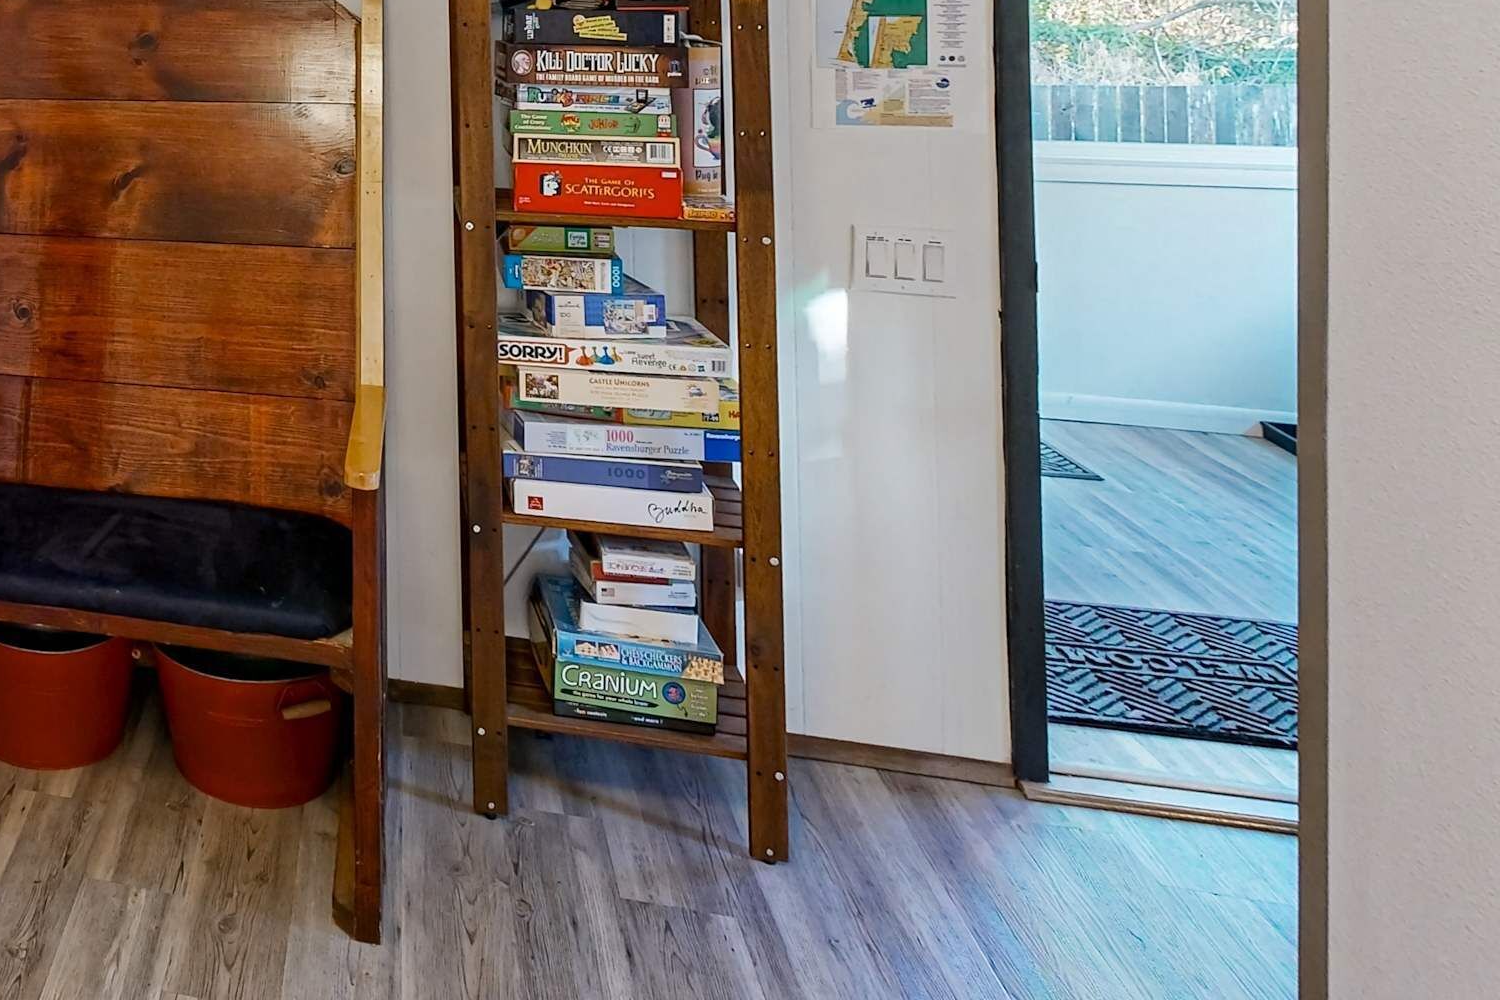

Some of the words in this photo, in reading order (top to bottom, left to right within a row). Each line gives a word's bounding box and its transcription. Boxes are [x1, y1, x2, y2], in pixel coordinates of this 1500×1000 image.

[536, 50, 564, 71] KILL
[566, 50, 614, 72] DOCTOR
[616, 51, 660, 73] LUCKY
[536, 73, 545, 81] THE
[546, 73, 564, 81] FAMILY
[527, 138, 592, 156] MUNCHKIN
[565, 183, 655, 199] SCATTERGORIES
[612, 266, 621, 288] 1000
[499, 344, 563, 361] SORRY!
[631, 358, 667, 369] Revenge
[588, 377, 613, 386] CASTLE
[613, 378, 650, 388] UNICORNS
[605, 429, 635, 444] 1000
[605, 442, 662, 456] Ravensburger
[663, 445, 690, 455] Puzzle
[607, 467, 646, 479] 1000
[647, 500, 708, 524] Buddha
